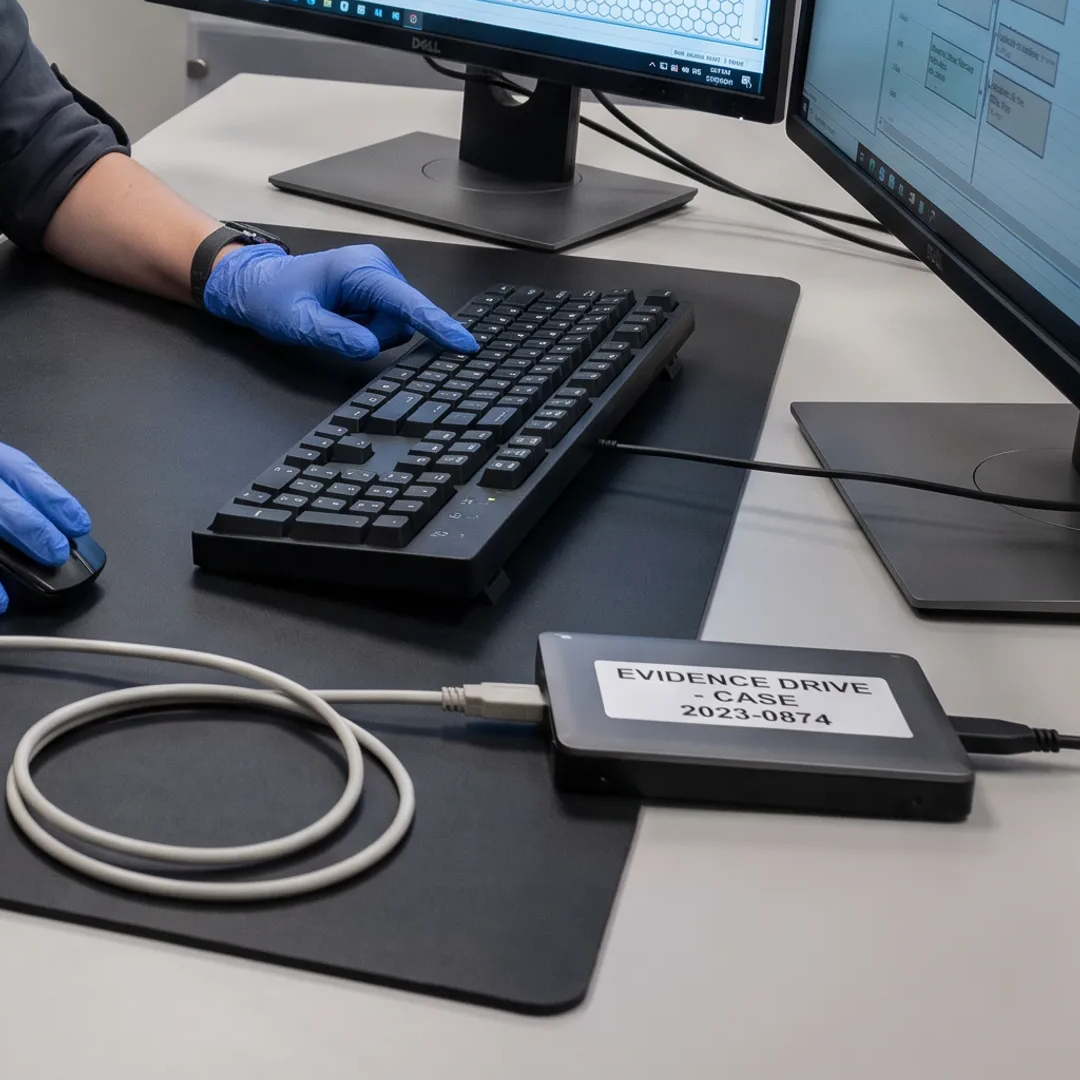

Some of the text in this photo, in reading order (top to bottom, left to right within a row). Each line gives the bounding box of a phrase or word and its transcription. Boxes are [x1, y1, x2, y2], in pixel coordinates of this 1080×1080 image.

[411, 36, 441, 54] DELL
[617, 667, 872, 695] EVIDENCE DRIVE
[714, 690, 799, 707] CASE
[680, 704, 833, 726] 2023-0874
